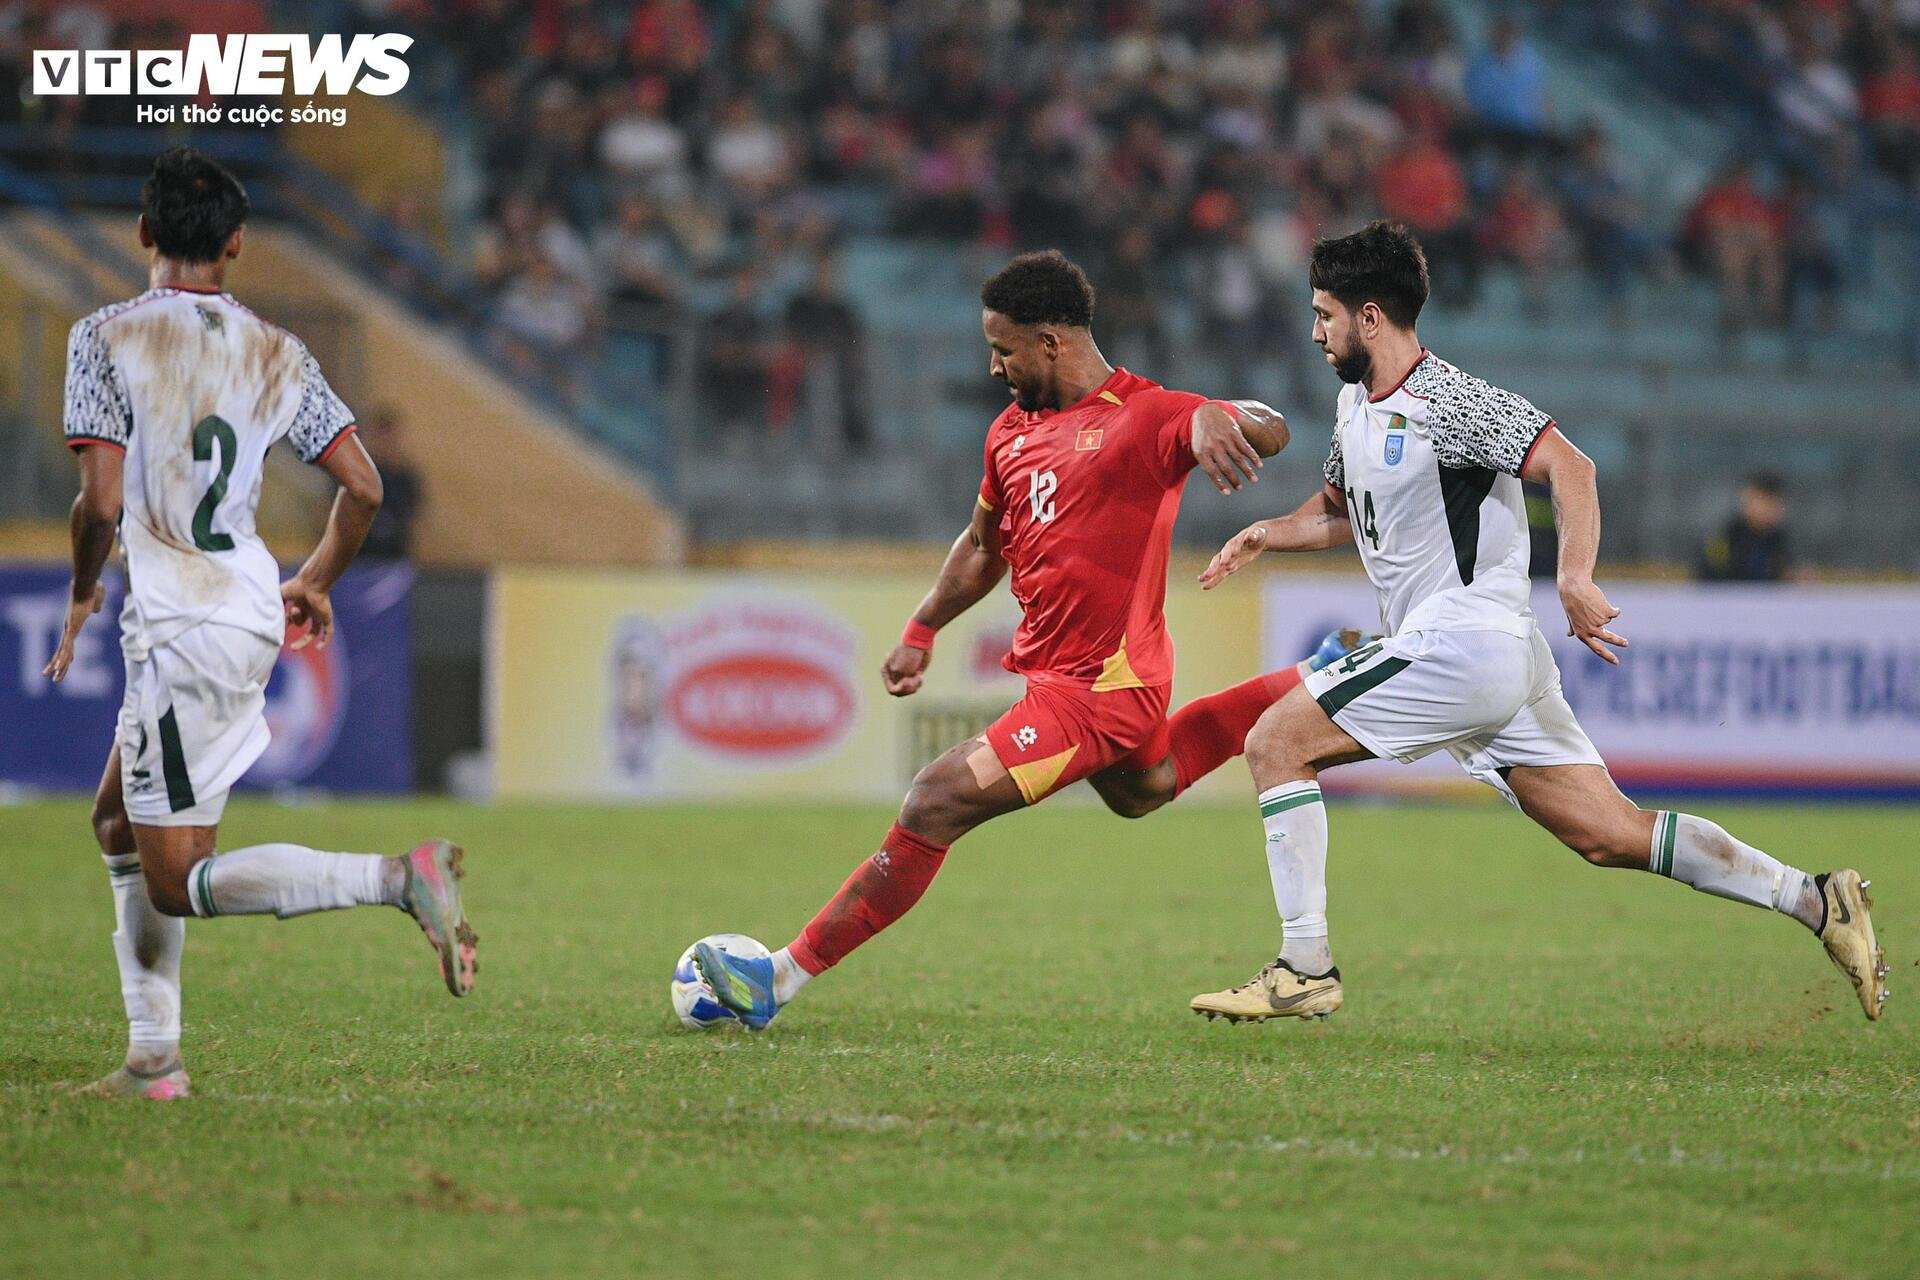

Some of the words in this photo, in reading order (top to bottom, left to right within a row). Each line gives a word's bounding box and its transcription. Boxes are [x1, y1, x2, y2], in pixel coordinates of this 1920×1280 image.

[192, 415, 236, 552] 2
[1029, 469, 1057, 524] 12
[1347, 487, 1379, 551] 14
